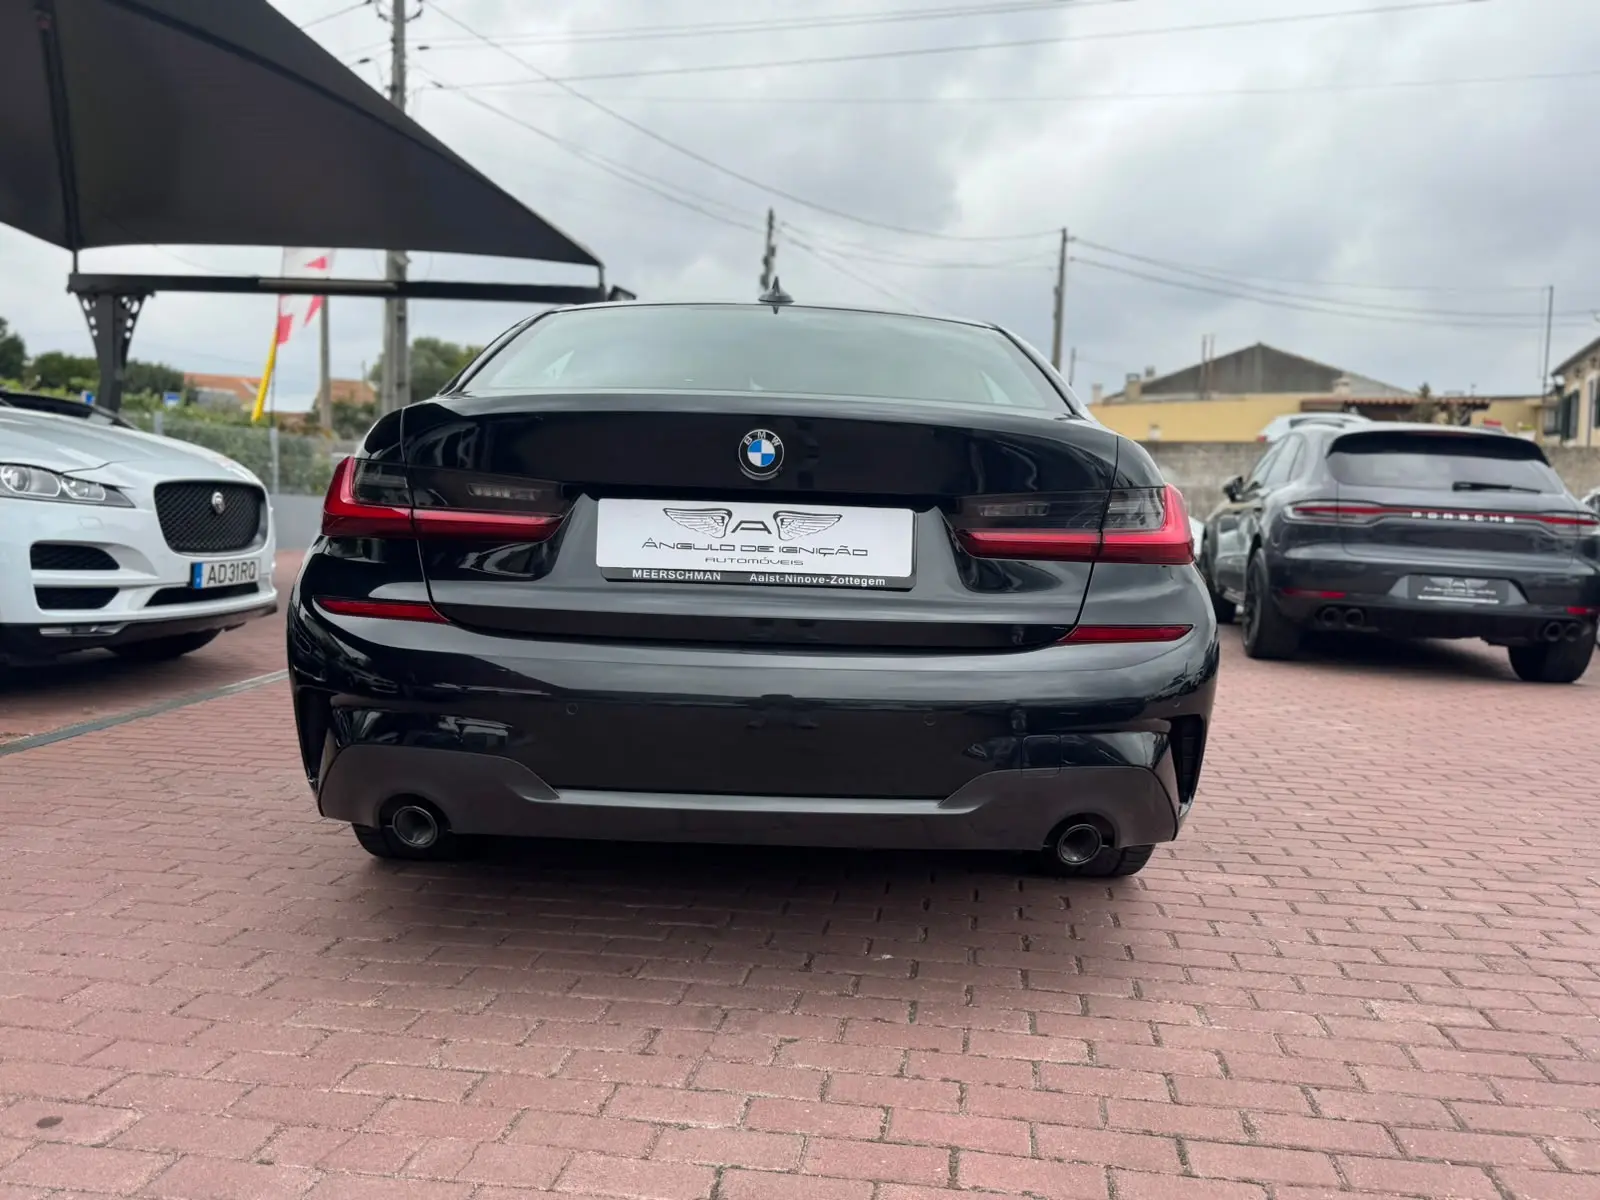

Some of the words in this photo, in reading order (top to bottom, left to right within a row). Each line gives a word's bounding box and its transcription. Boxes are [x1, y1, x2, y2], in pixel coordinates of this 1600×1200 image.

[743, 431, 781, 446] BMW
[641, 537, 736, 552] ÂNGULO
[740, 544, 774, 553] DE
[778, 544, 868, 557] IGNIÇÃO
[632, 568, 721, 581] MEERSCHMAN
[749, 572, 886, 587] Aalst-Ninove-Zottegem
